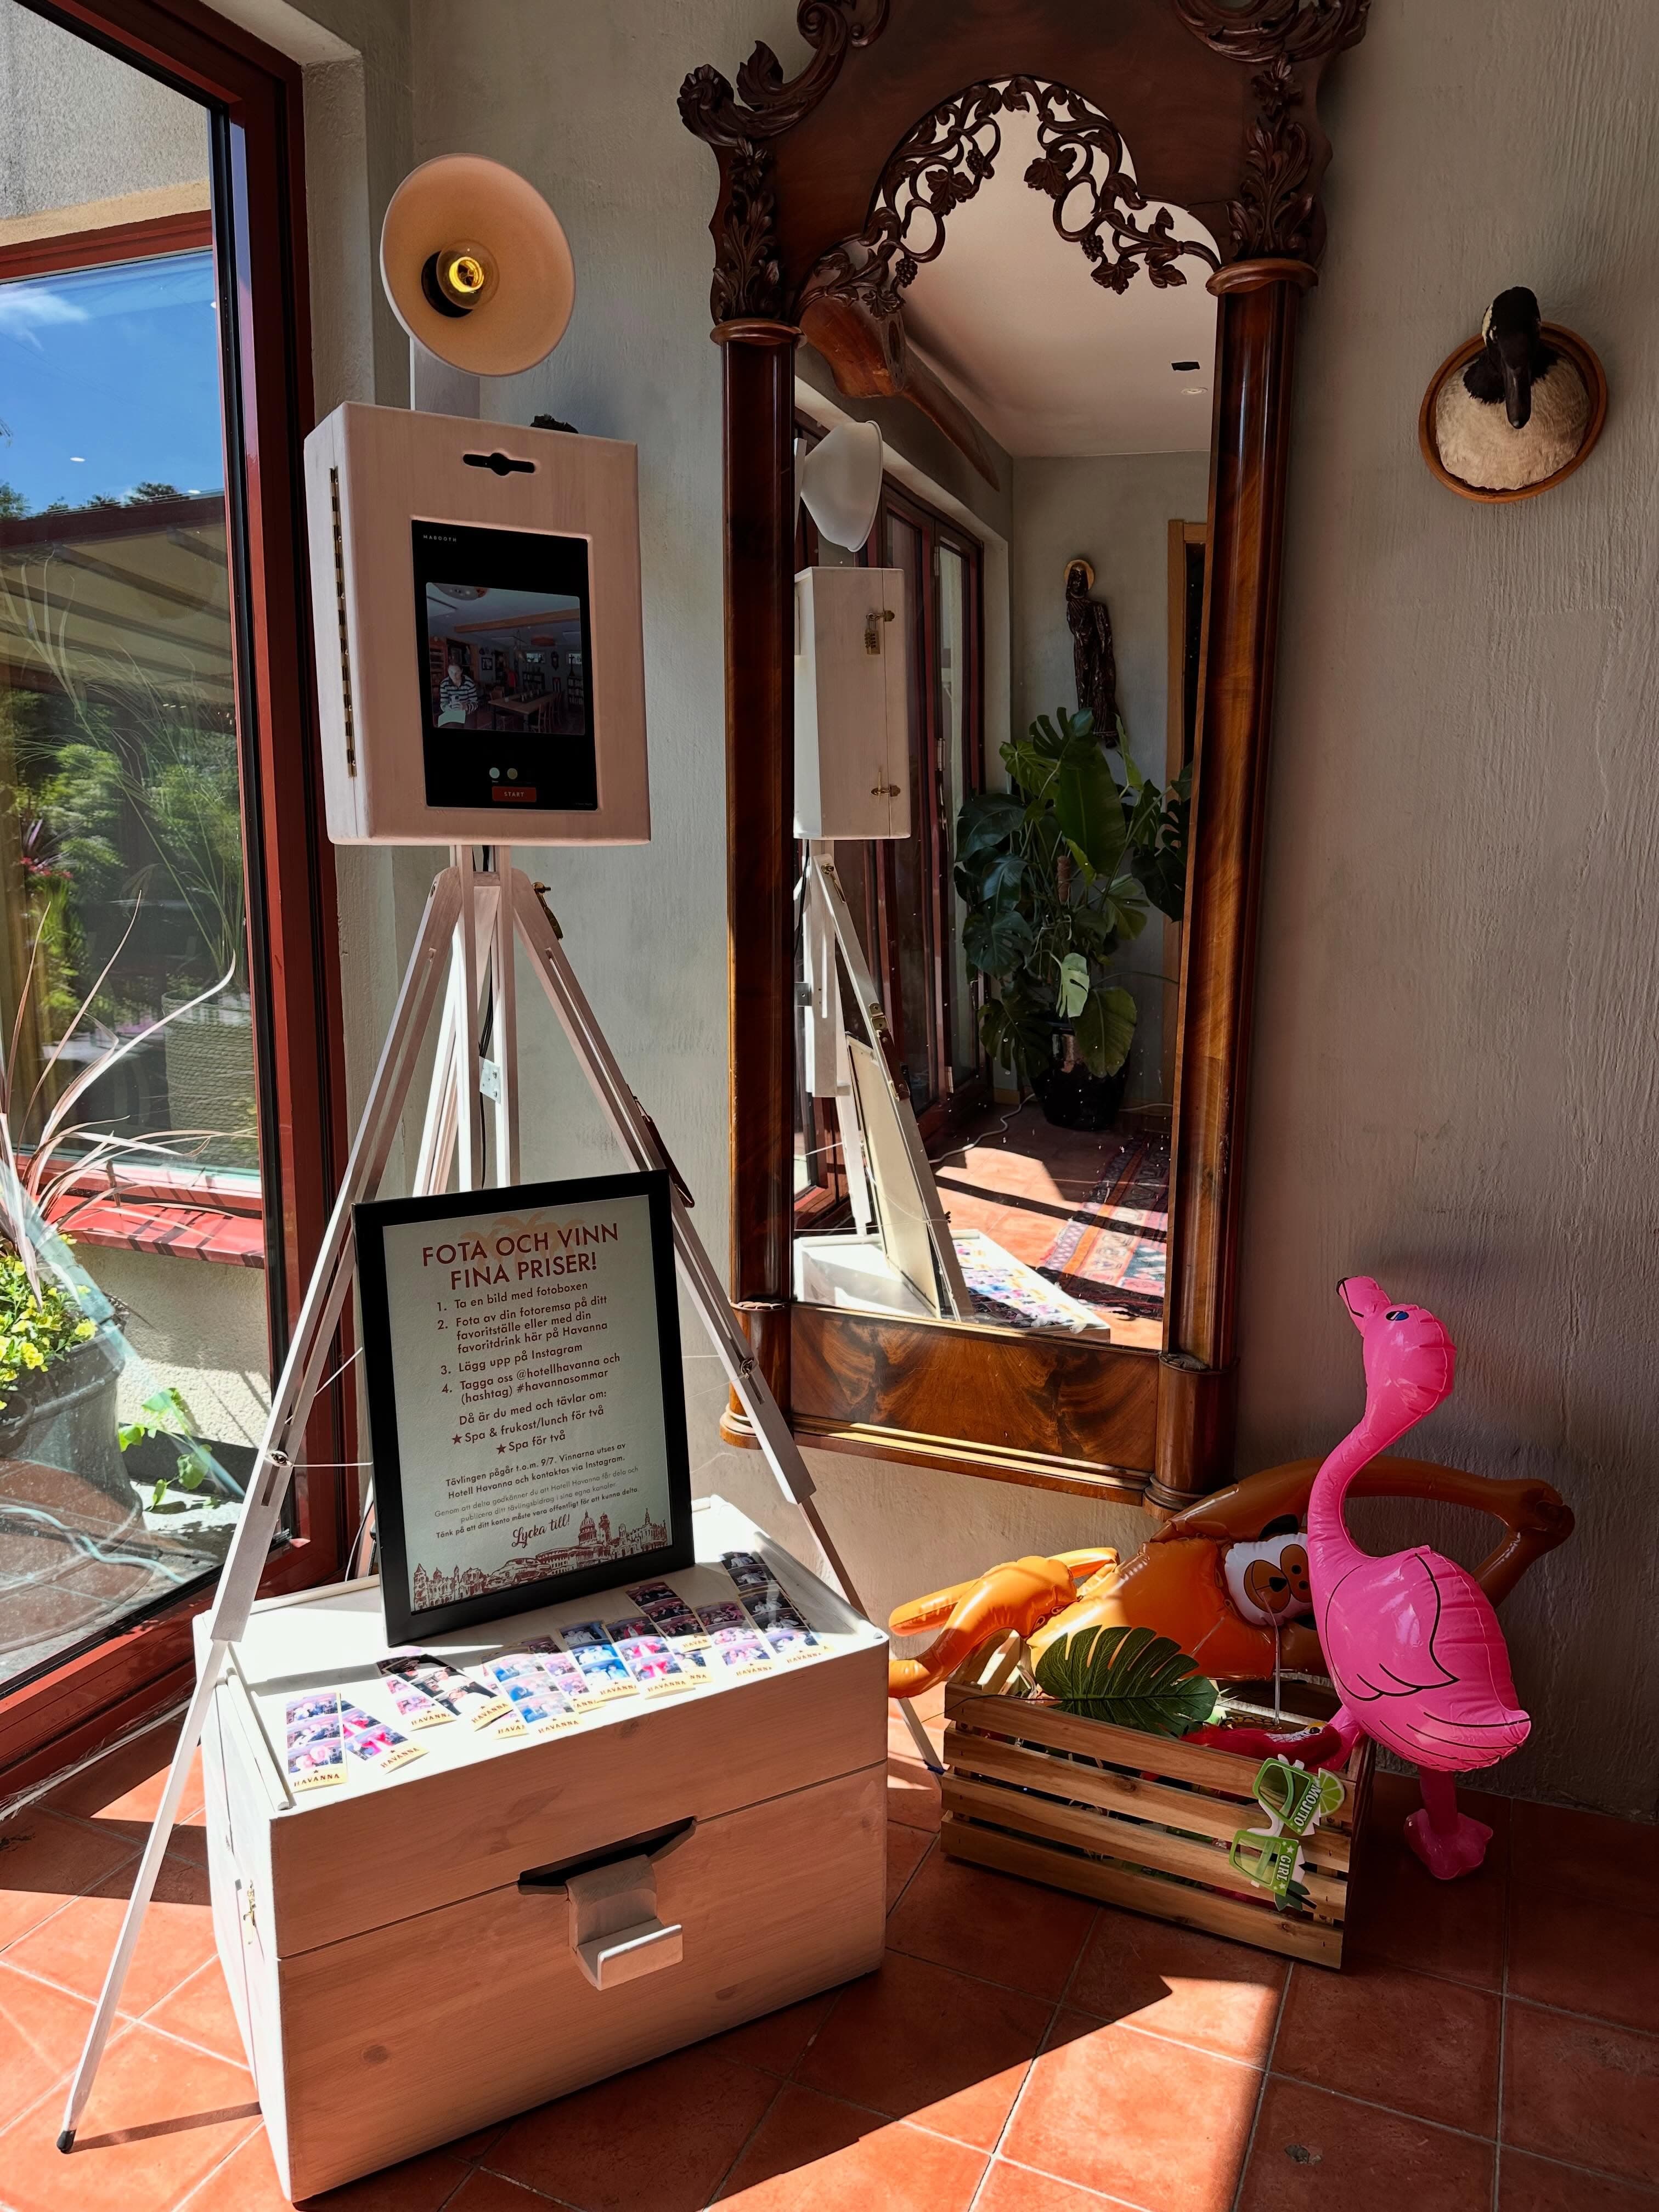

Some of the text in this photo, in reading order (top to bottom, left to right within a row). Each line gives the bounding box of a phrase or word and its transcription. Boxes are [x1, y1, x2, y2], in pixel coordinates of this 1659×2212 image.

[422, 1223, 618, 1267] FOTA OCH VINN
[451, 1251, 597, 1290] FINA PRISER!
[437, 1283, 588, 1312] 1. Ta en bild med fotoboxen
[437, 1295, 607, 1331] 2. Fota av din fotoremsa på ditt
[456, 1311, 591, 1341] favoritställe eller med din
[457, 1323, 608, 1354] favoritdrink här på Havanna
[441, 1344, 583, 1375] 3. Lägg upp på Instagram
[441, 1352, 620, 1393] 4. Tagga oss @hotellhavanna och
[461, 1370, 608, 1406] (hashtag) #havannasommar
[459, 1391, 607, 1425] Då är du med och tävlar om:
[465, 1404, 604, 1444] Spa & frukost/lunch för två
[509, 1429, 566, 1453] Spa för två
[445, 1474, 486, 1487] Tävlingen
[489, 1465, 514, 1480] pågår
[516, 1463, 539, 1472] t.o.m.
[541, 1457, 557, 1466] 9/7.
[558, 1450, 595, 1462] Vinnarna
[597, 1446, 615, 1454] utses
[448, 1456, 625, 1499] Hotell Havanna och kontaktas via Instagram.
[434, 1508, 460, 1517] Genom
[472, 1500, 490, 1509] delta
[492, 1492, 528, 1506] godkänner
[550, 1480, 570, 1492] Hotell
[572, 1476, 600, 1487] Havanna
[602, 1471, 612, 1480] får
[627, 1465, 639, 1474] och
[436, 1529, 453, 1539] Tänk
[455, 1525, 465, 1536] på
[477, 1521, 489, 1530] ditt
[491, 1517, 510, 1526] konto
[549, 1500, 579, 1513] offentligt
[601, 1492, 620, 1500] kunna
[460, 1511, 493, 1524] publicera
[511, 1514, 569, 1549] Lycka till!
[647, 1680, 686, 1692] HAVANNA
[472, 1702, 509, 1723] HAVANNA
[538, 1720, 579, 1734] HAVANNA
[380, 1747, 420, 1768] HAVANNA
[294, 1773, 340, 1787] HAVANNA
[1294, 1784, 1322, 1827] MOJITO
[1277, 1854, 1291, 1882] GIRL
